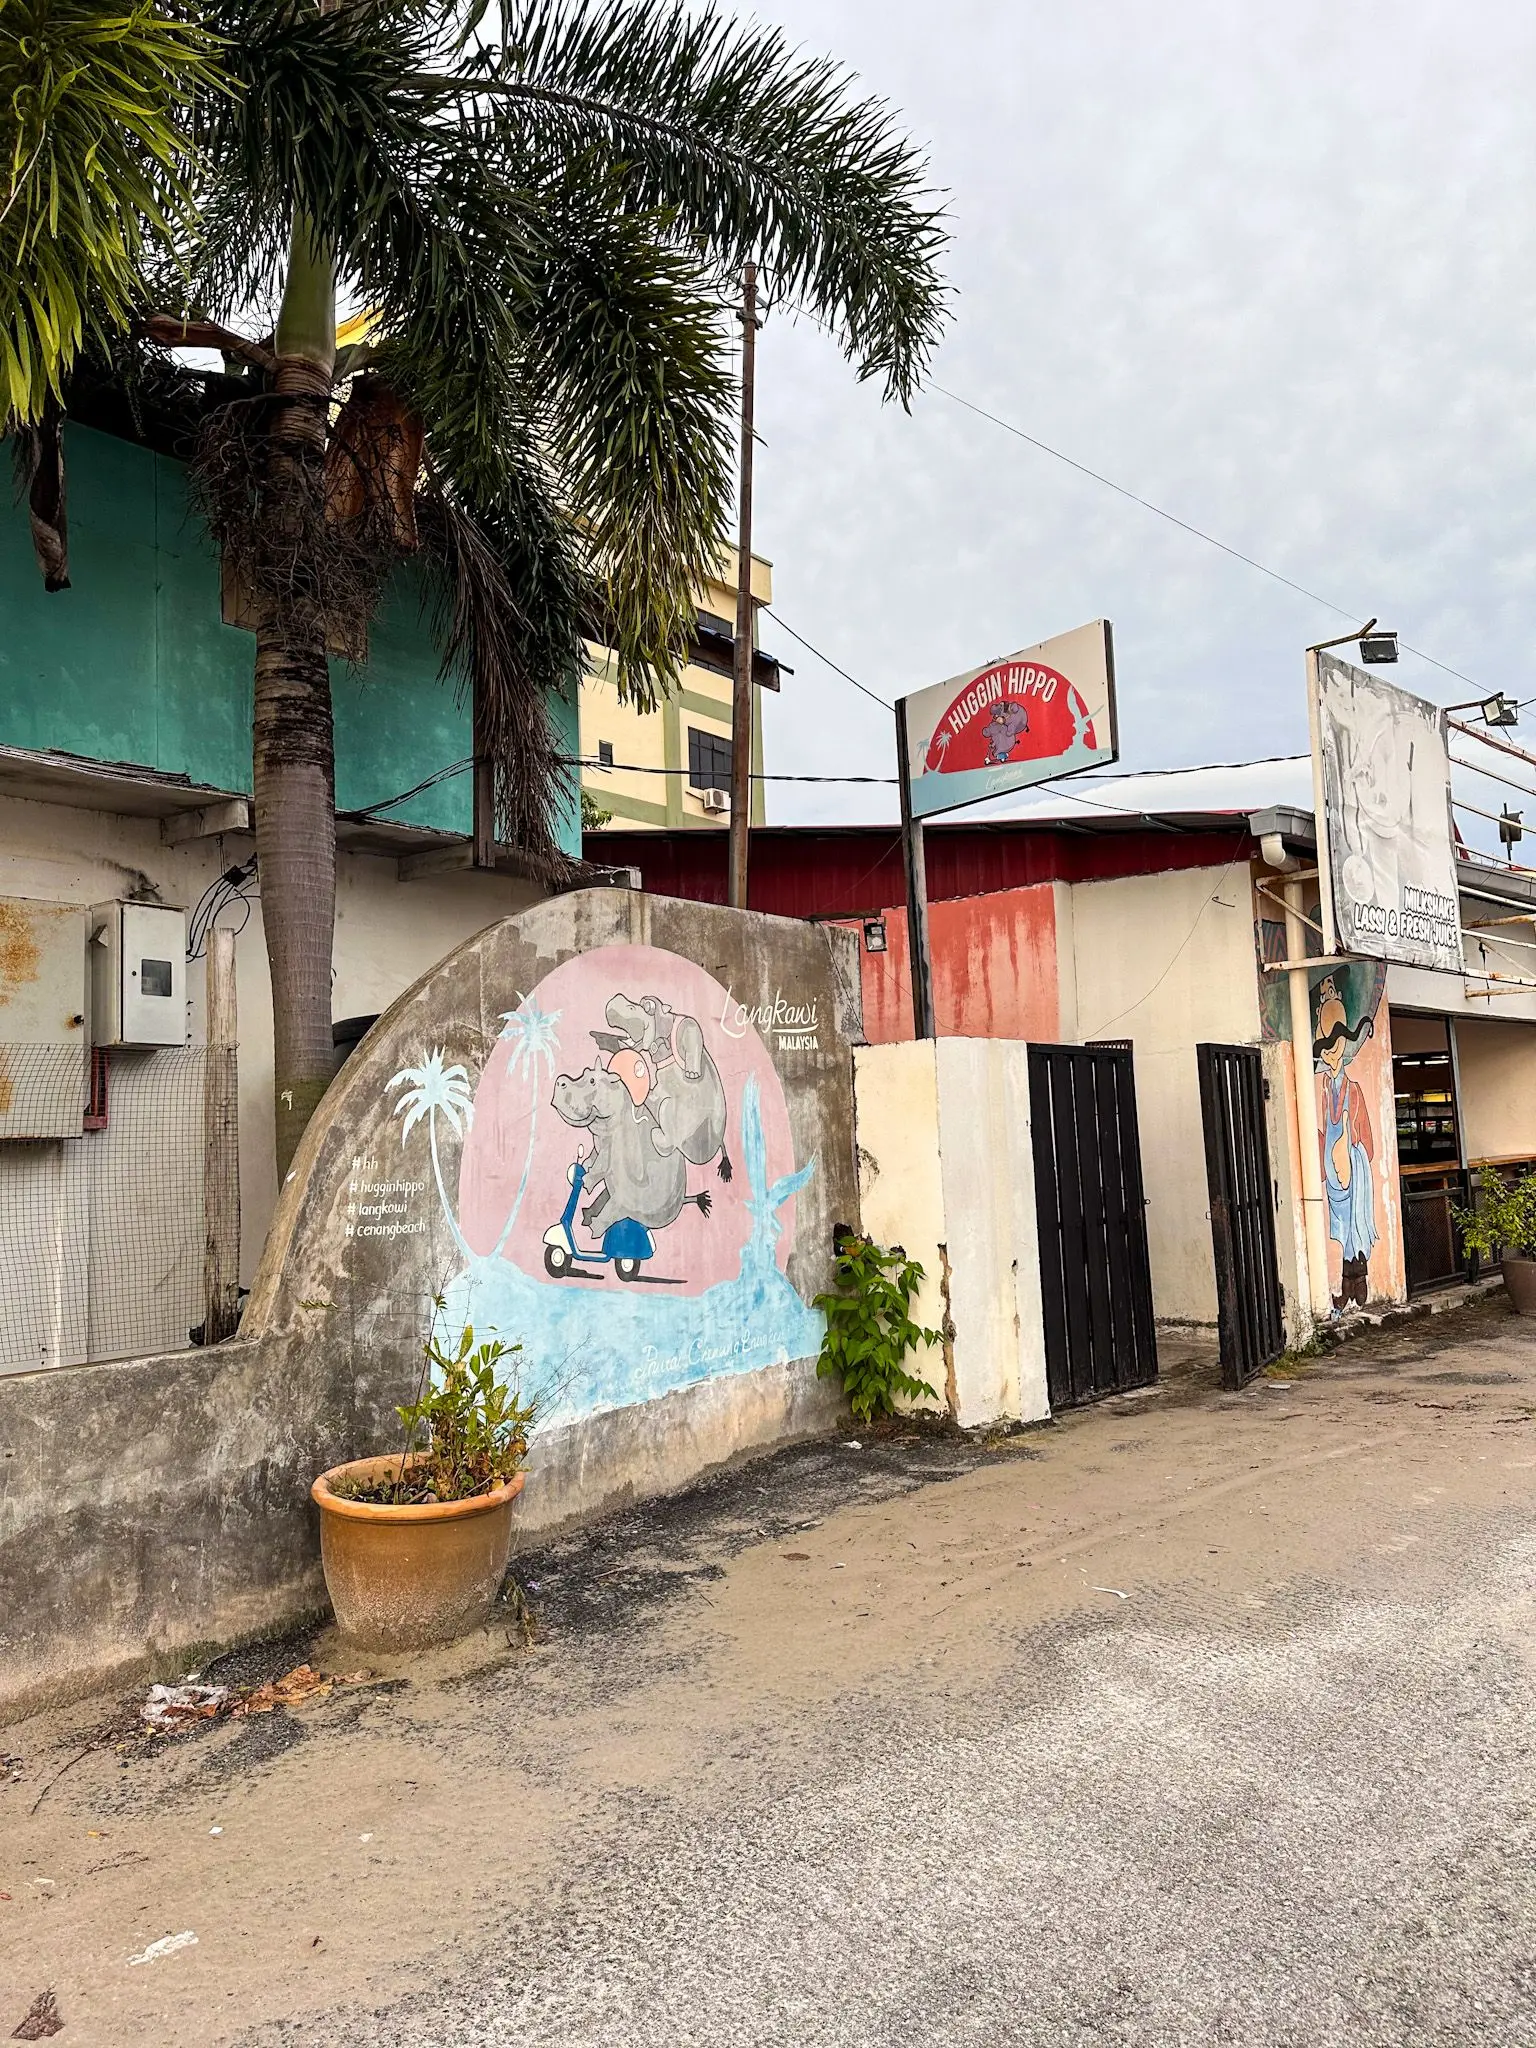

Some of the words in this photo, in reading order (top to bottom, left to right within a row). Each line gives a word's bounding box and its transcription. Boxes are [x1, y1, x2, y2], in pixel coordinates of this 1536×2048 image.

[1008, 667, 1058, 703] HIPPO
[1403, 886, 1455, 922] MILKSHAKE
[1354, 902, 1386, 934] LASSI
[1388, 909, 1398, 936] &
[1400, 912, 1431, 943] FRESH
[1432, 919, 1458, 949] JUICE
[720, 984, 819, 1038] Langkawi
[778, 1035, 819, 1051] MALAYSIA
